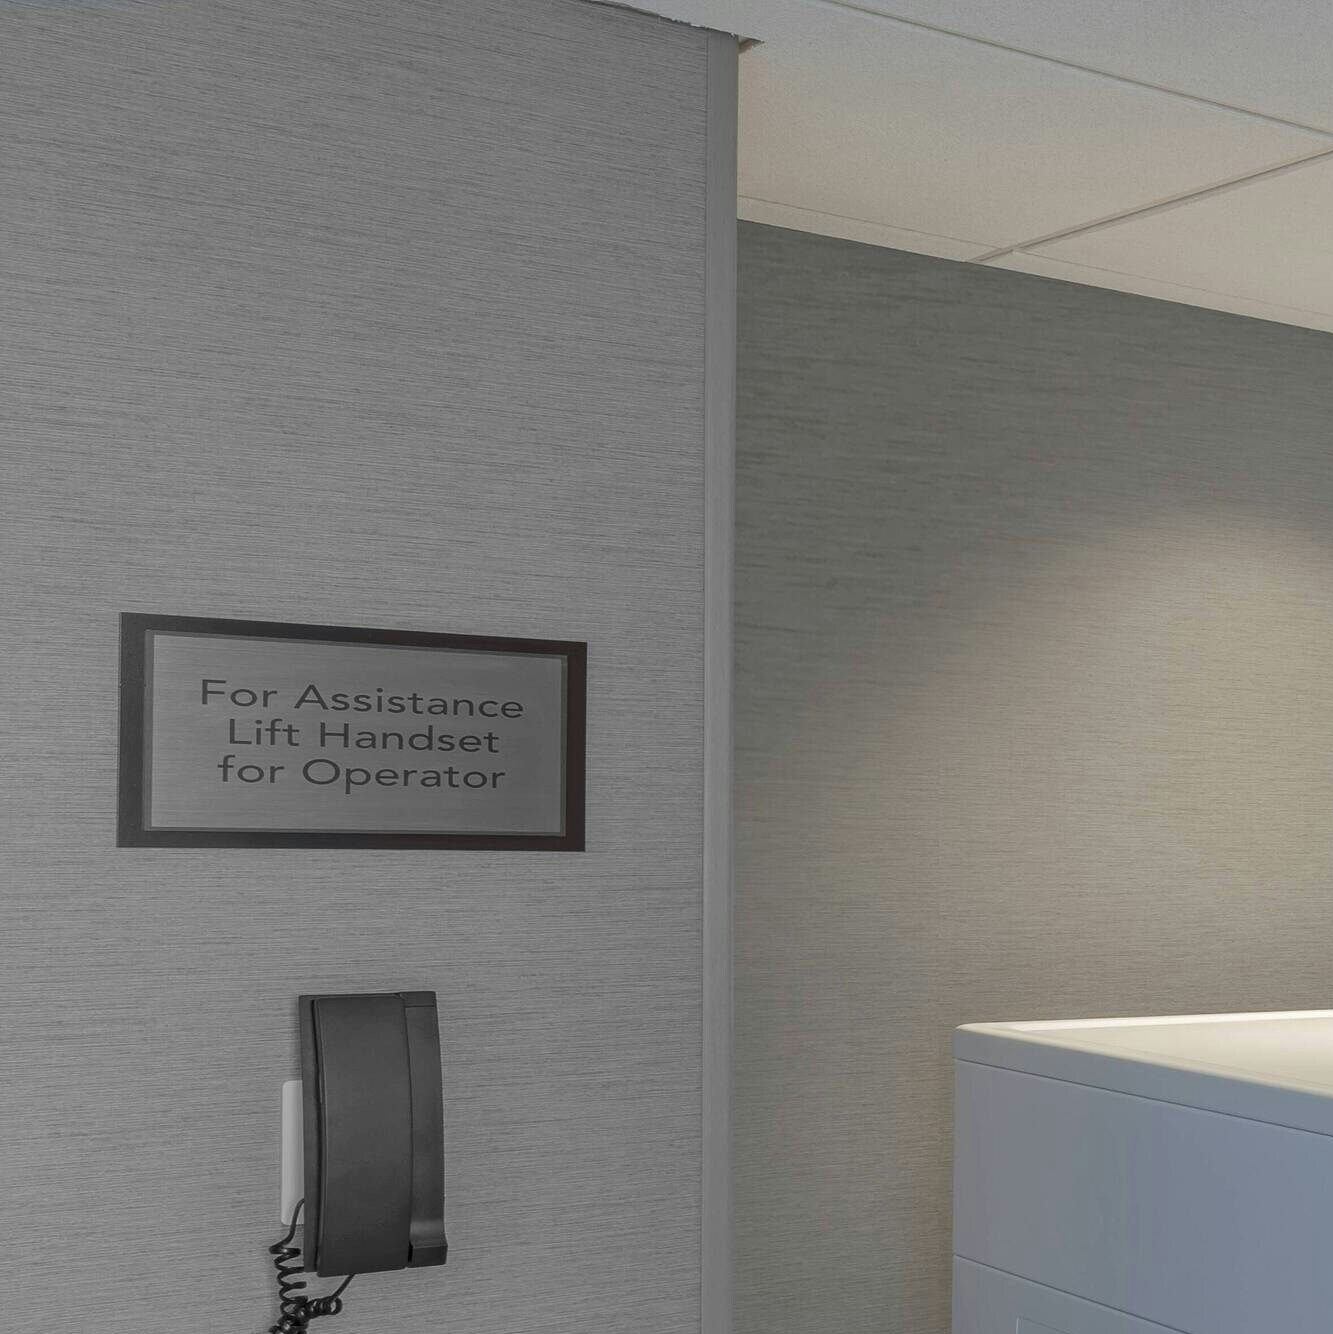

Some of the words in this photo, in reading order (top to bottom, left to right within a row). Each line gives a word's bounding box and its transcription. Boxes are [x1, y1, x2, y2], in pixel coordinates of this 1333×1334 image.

[200, 678, 278, 708] For
[294, 684, 524, 719] Assistance
[228, 718, 300, 748] Lift
[319, 722, 500, 754] Handset
[217, 755, 285, 784] for
[302, 758, 506, 795] Operator
